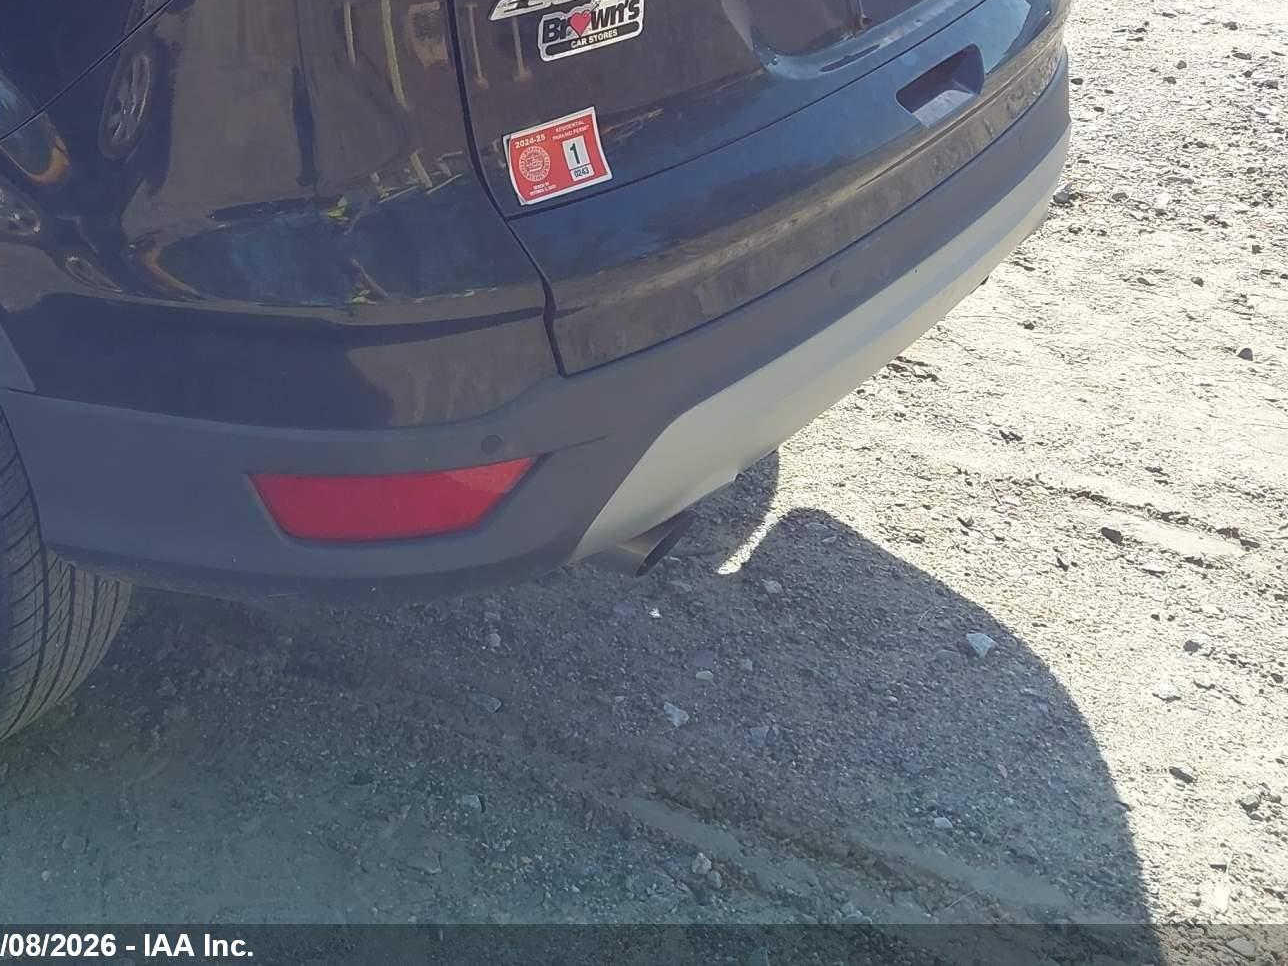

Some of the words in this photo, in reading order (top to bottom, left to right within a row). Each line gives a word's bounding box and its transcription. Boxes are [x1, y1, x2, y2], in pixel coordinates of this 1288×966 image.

[570, 37, 588, 49] CAR
[589, 29, 618, 44] STORES
[514, 133, 546, 149] 2024-25
[569, 142, 581, 165] 1
